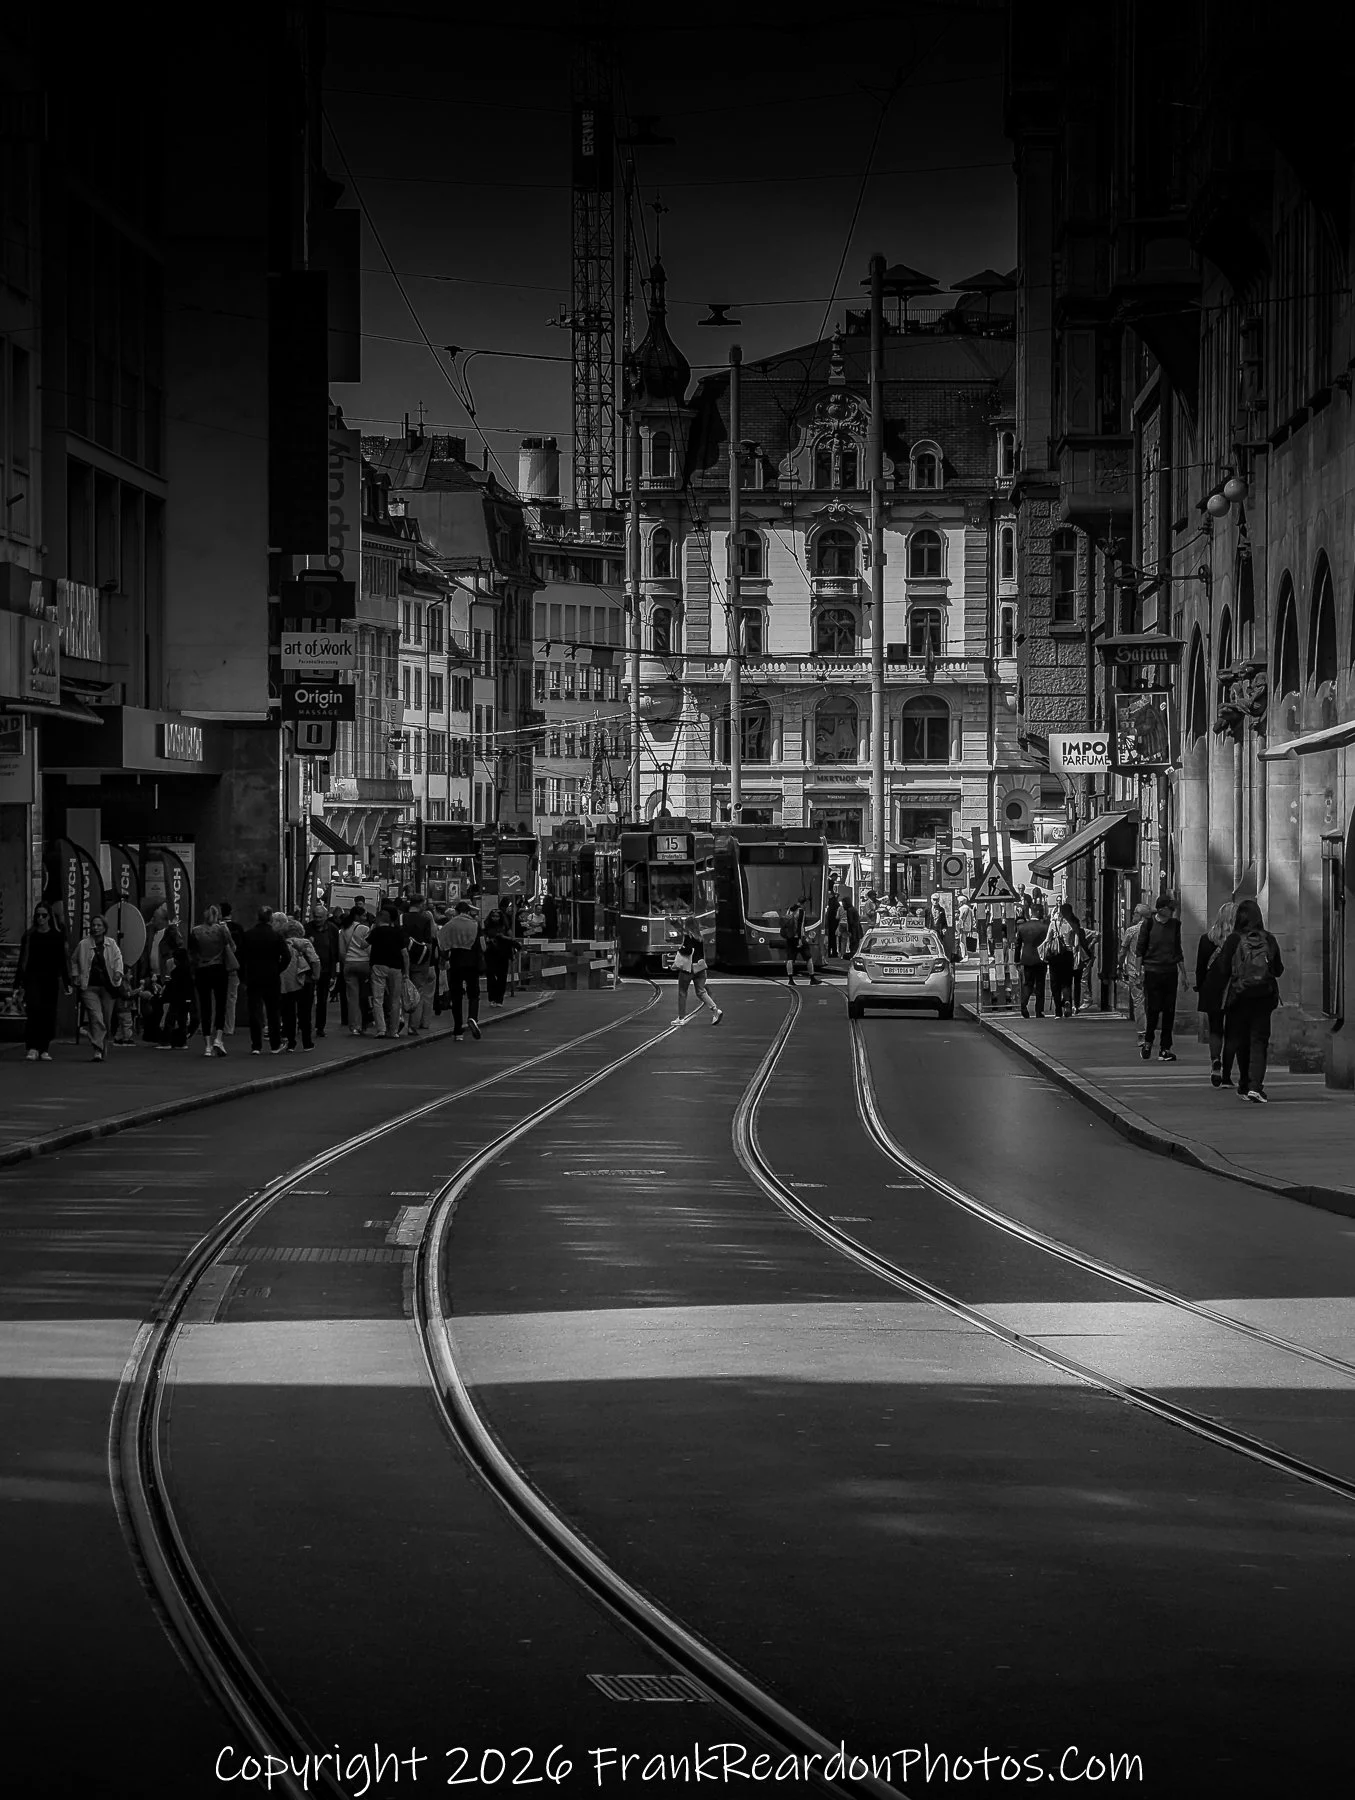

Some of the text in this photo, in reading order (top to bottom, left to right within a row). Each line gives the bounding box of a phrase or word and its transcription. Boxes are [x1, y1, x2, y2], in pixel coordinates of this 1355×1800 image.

[581, 109, 595, 156] ERNE
[284, 639, 353, 657] art of work
[1114, 646, 1168, 663] Safran
[294, 688, 343, 708] Origin
[1062, 741, 1107, 755] IMPO
[665, 837, 679, 850] 15
[778, 848, 785, 860] 8
[907, 920, 925, 928] TAXI
